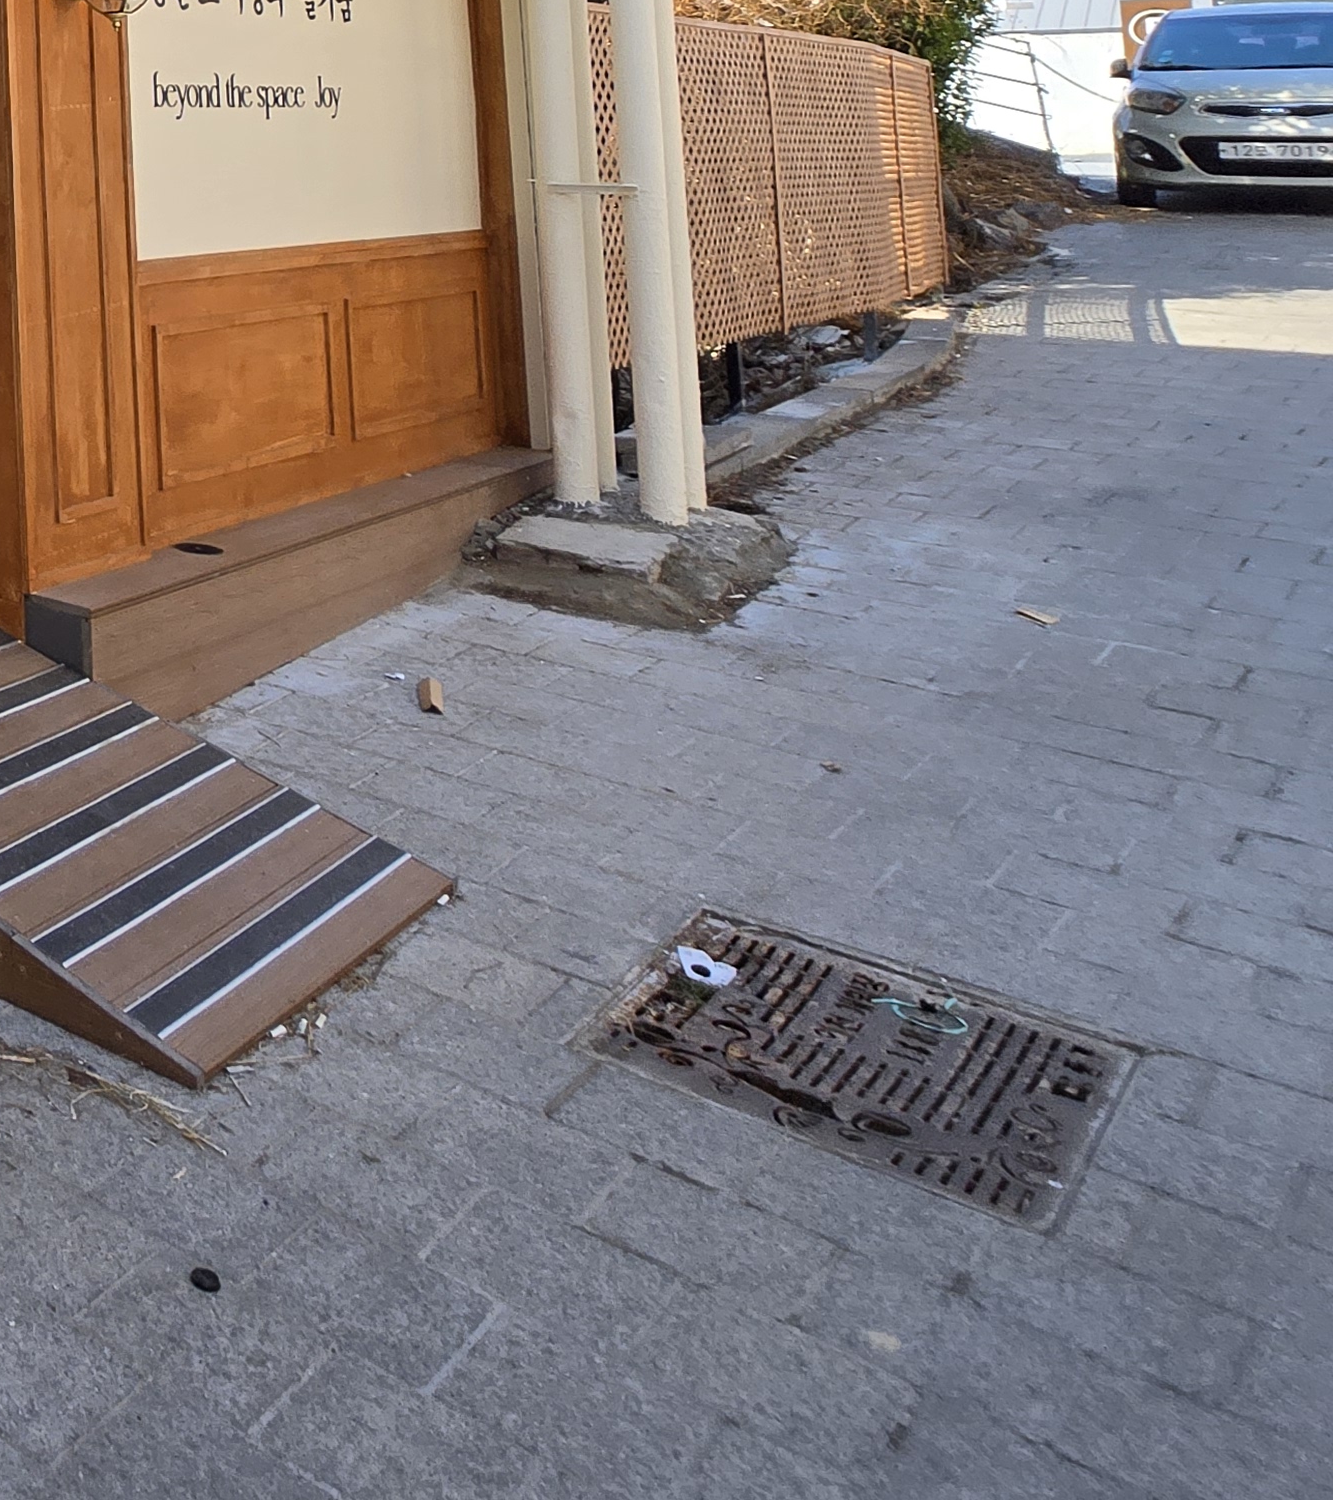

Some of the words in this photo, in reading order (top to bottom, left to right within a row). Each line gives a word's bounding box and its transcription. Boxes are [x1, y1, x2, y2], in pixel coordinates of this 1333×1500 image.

[152, 70, 222, 120] beyond
[225, 72, 254, 109] the
[256, 84, 306, 120] space
[314, 74, 342, 120] Joy
[1275, 144, 1330, 158] 7019
